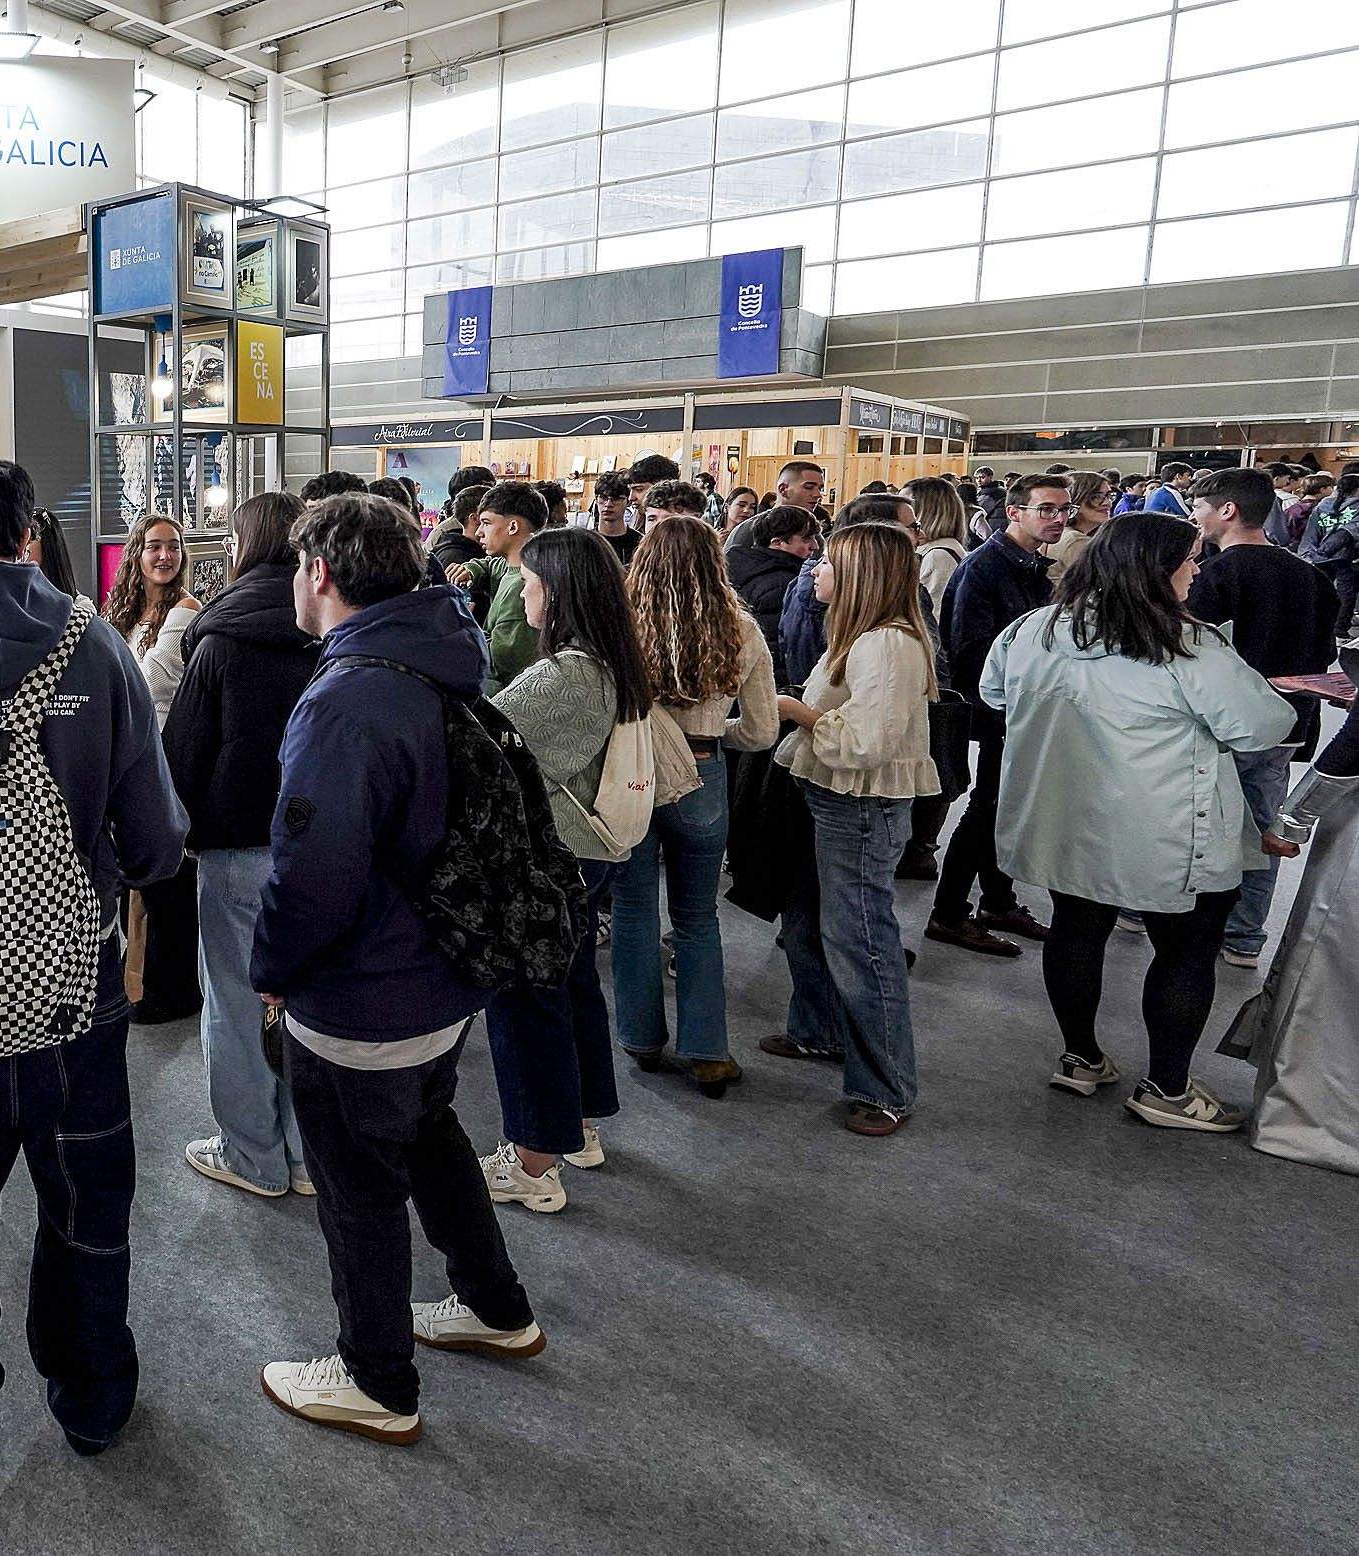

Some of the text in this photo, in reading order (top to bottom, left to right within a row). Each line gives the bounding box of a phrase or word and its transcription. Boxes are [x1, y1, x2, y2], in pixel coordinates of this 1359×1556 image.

[122, 246, 146, 257] XUNTA
[122, 251, 161, 266] DE GALICIA
[250, 341, 265, 361] ES
[253, 361, 269, 380] CE
[256, 381, 274, 400] NA
[58, 694, 79, 702] DON'T
